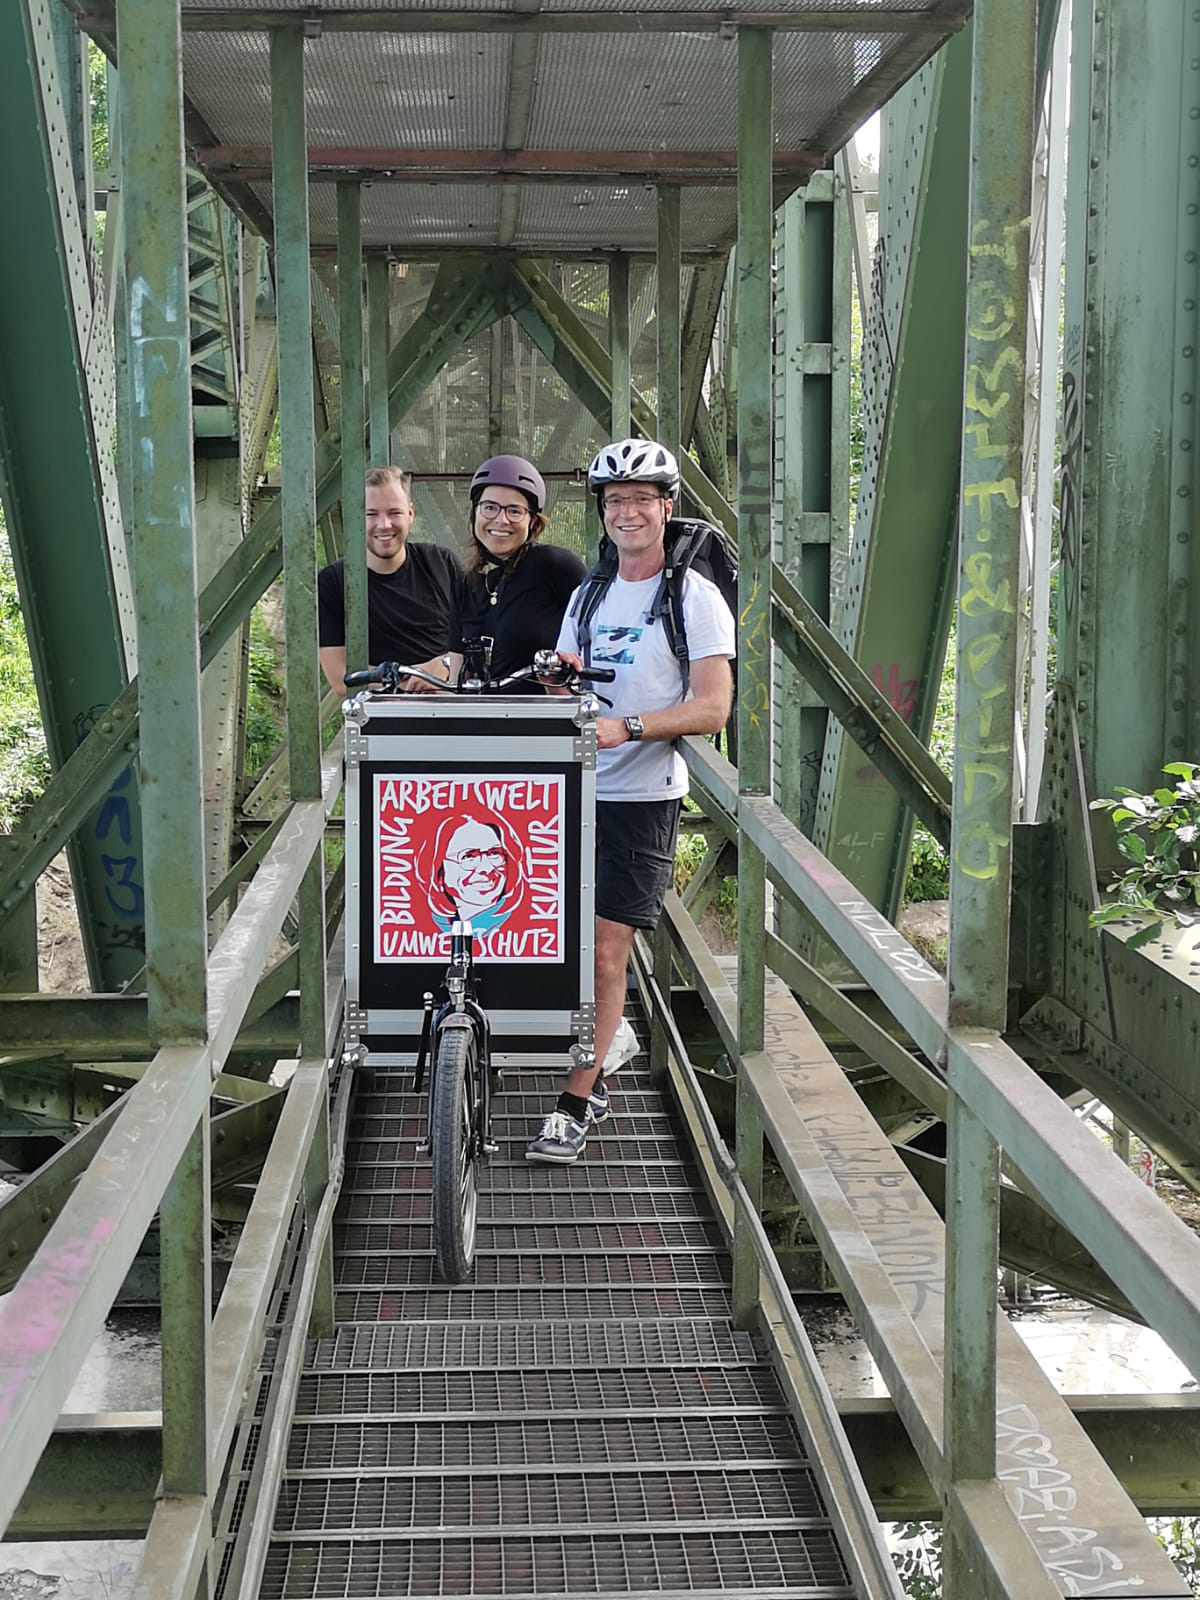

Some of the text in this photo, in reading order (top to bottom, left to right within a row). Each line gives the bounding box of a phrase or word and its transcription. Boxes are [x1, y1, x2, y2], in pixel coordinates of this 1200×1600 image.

[380, 780, 559, 814] ARBEITSWELT
[380, 816, 415, 926] BILDUNG
[526, 814, 559, 921] KULTUR
[382, 928, 558, 958] UMWESCHUTZ
